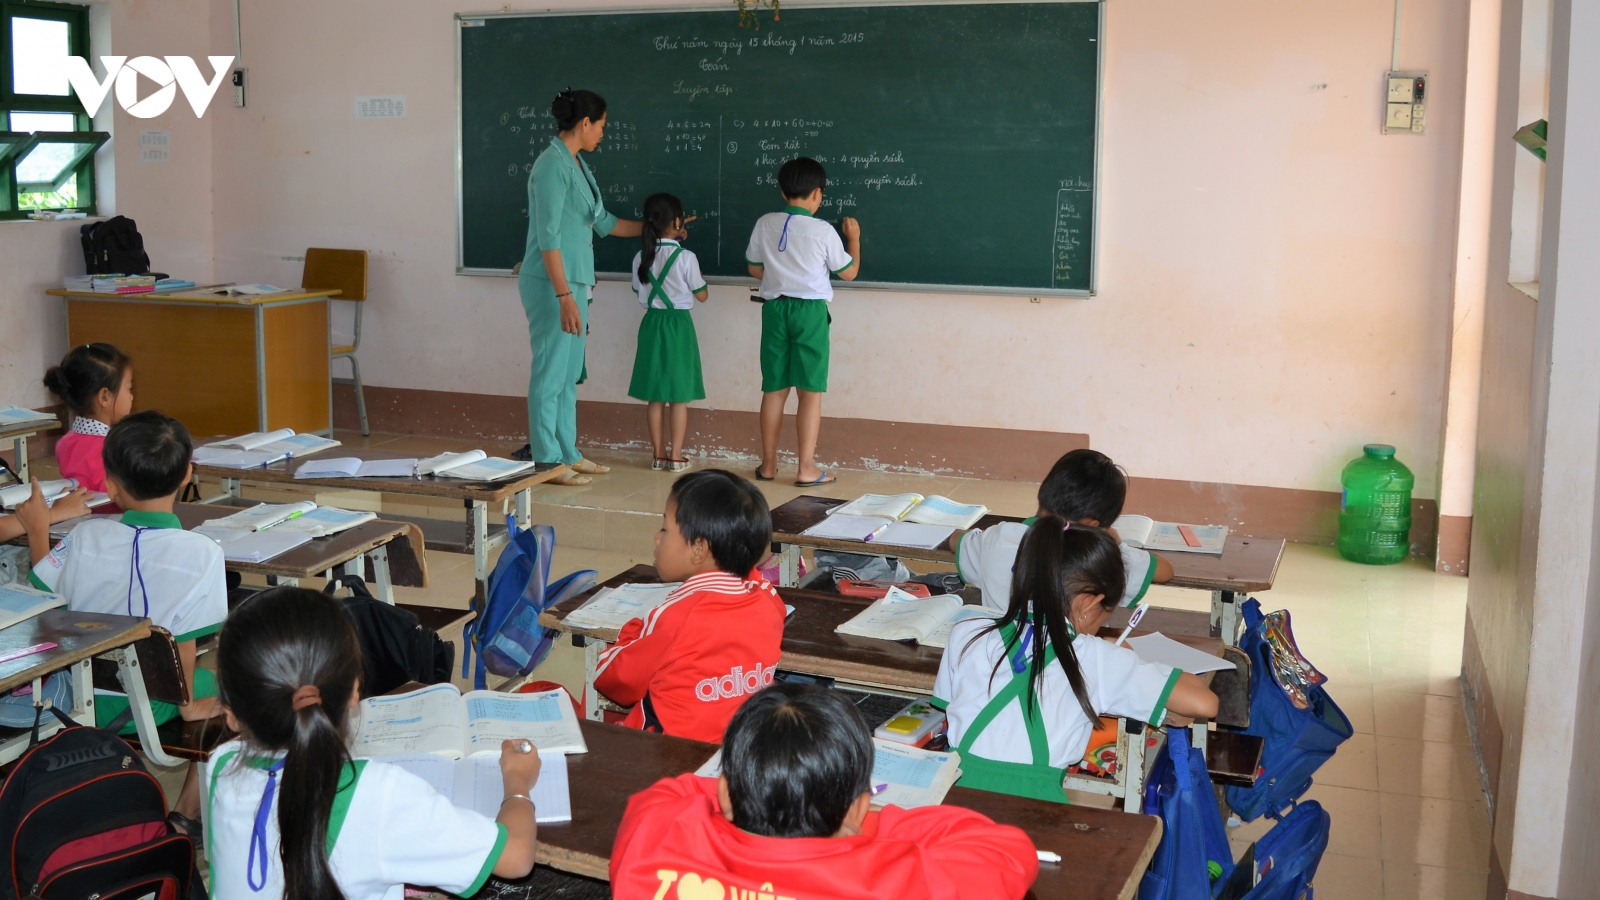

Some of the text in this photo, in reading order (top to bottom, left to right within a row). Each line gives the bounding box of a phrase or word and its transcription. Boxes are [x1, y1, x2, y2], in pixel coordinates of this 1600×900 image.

[682, 37, 708, 48] năm
[713, 38, 743, 55] ngày
[748, 37, 759, 47] 15
[762, 32, 797, 55] tháng
[809, 35, 835, 46] năm
[839, 32, 865, 44] 2015
[614, 121, 620, 130] 9
[840, 154, 848, 163] 4
[756, 176, 763, 185] 5
[766, 172, 779, 188] họ
[695, 662, 778, 702] adida
